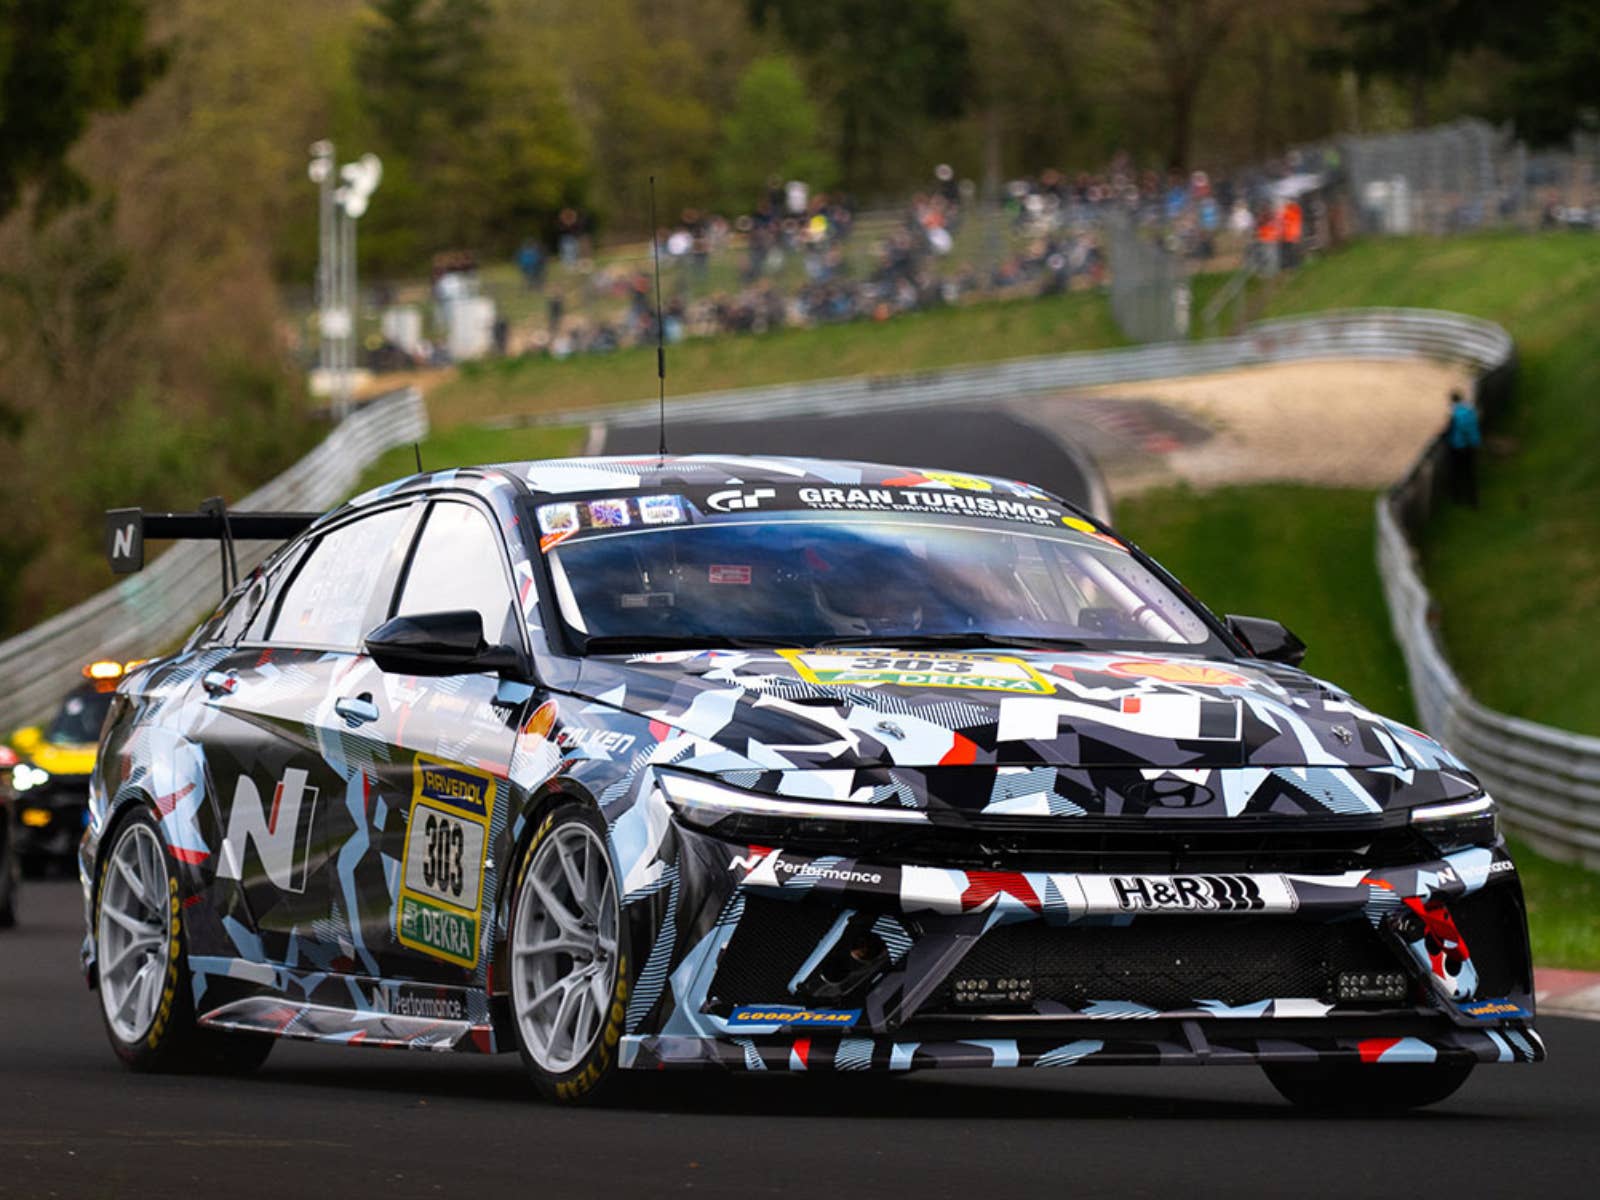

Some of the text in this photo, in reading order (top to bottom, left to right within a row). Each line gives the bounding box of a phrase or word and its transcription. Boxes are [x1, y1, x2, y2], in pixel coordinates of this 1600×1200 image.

[799, 488, 892, 504] GRAN
[847, 503, 891, 511] REAL
[894, 504, 960, 514] DRIVING
[963, 508, 1057, 526] SIMULATOR
[112, 523, 135, 558] N
[851, 657, 975, 673] 303
[898, 673, 1038, 690] DEKRA
[216, 767, 319, 894] N
[423, 814, 464, 897] 303
[774, 860, 882, 884] Performance
[1112, 877, 1210, 908] H&R
[422, 908, 471, 957] DEKRA
[392, 992, 461, 1018] Performance
[736, 1012, 852, 1022] GOODYEAR
